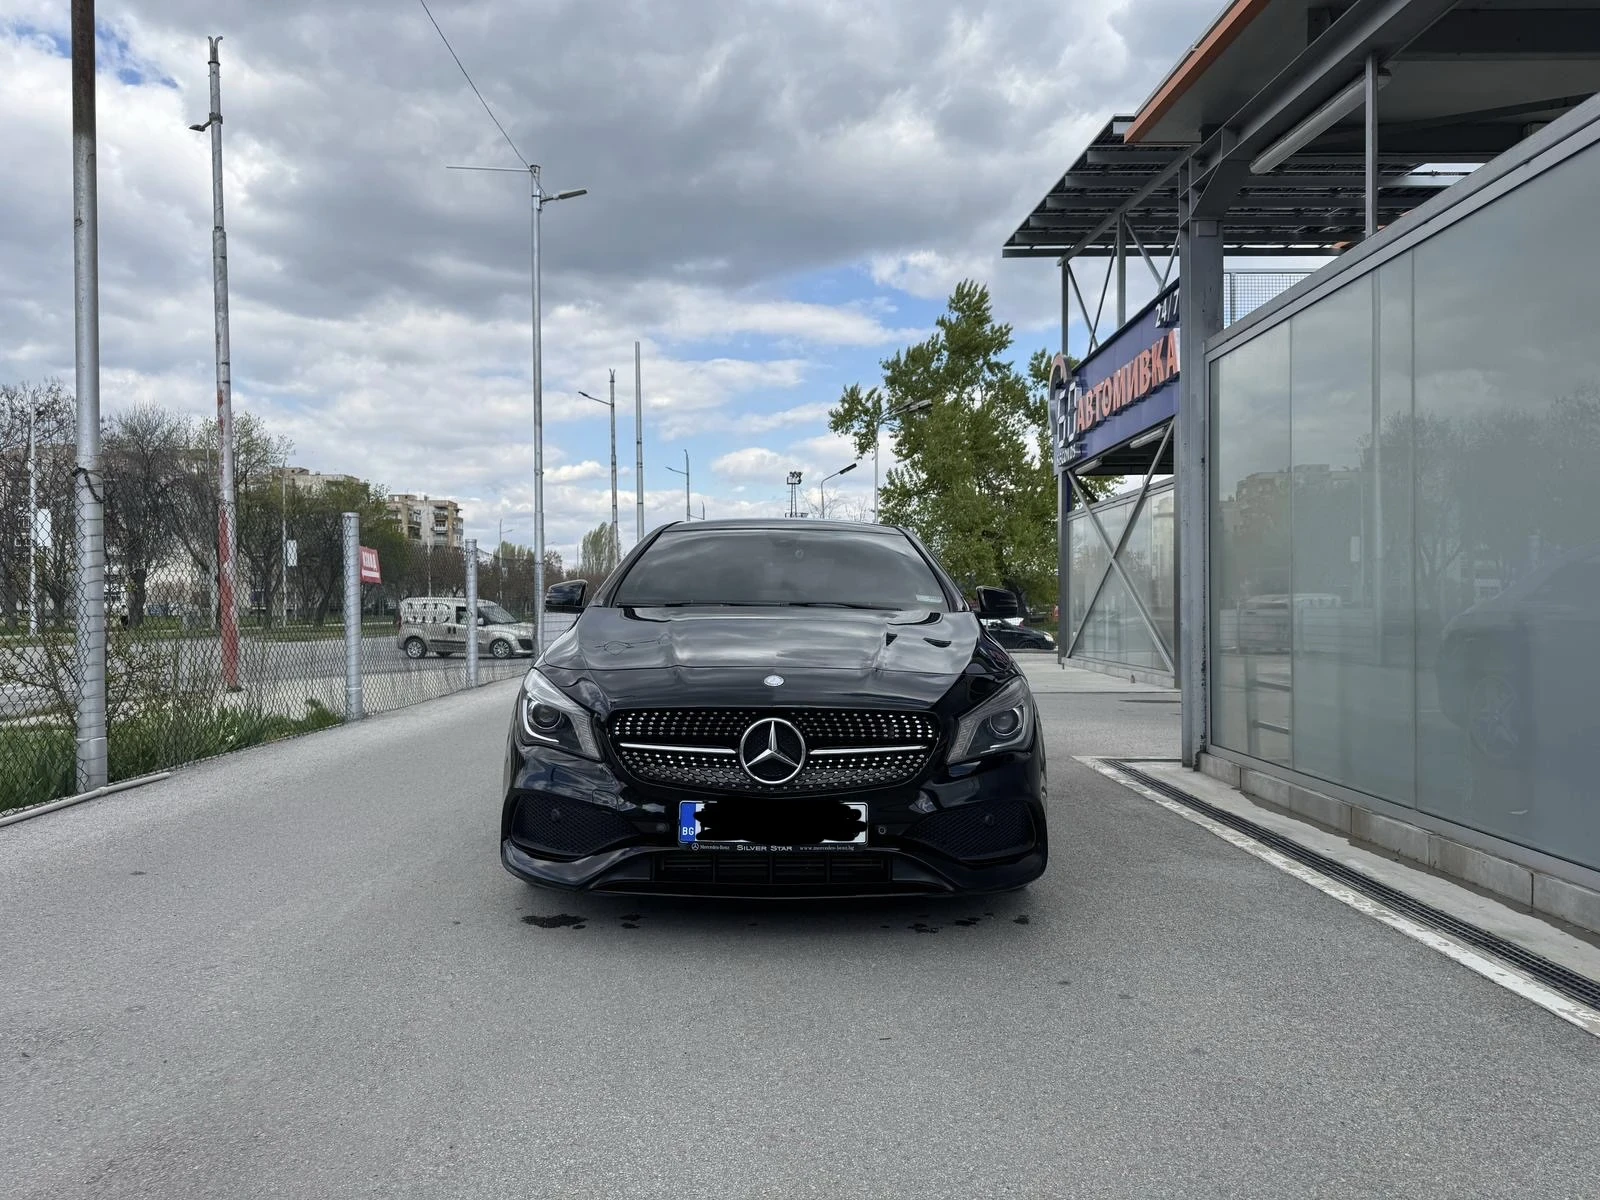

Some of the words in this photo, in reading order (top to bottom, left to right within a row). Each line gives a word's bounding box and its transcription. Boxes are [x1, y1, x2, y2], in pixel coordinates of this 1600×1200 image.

[1155, 287, 1180, 328] 24/7
[1077, 329, 1180, 434] АВТОМИВКА
[682, 826, 695, 836] BG
